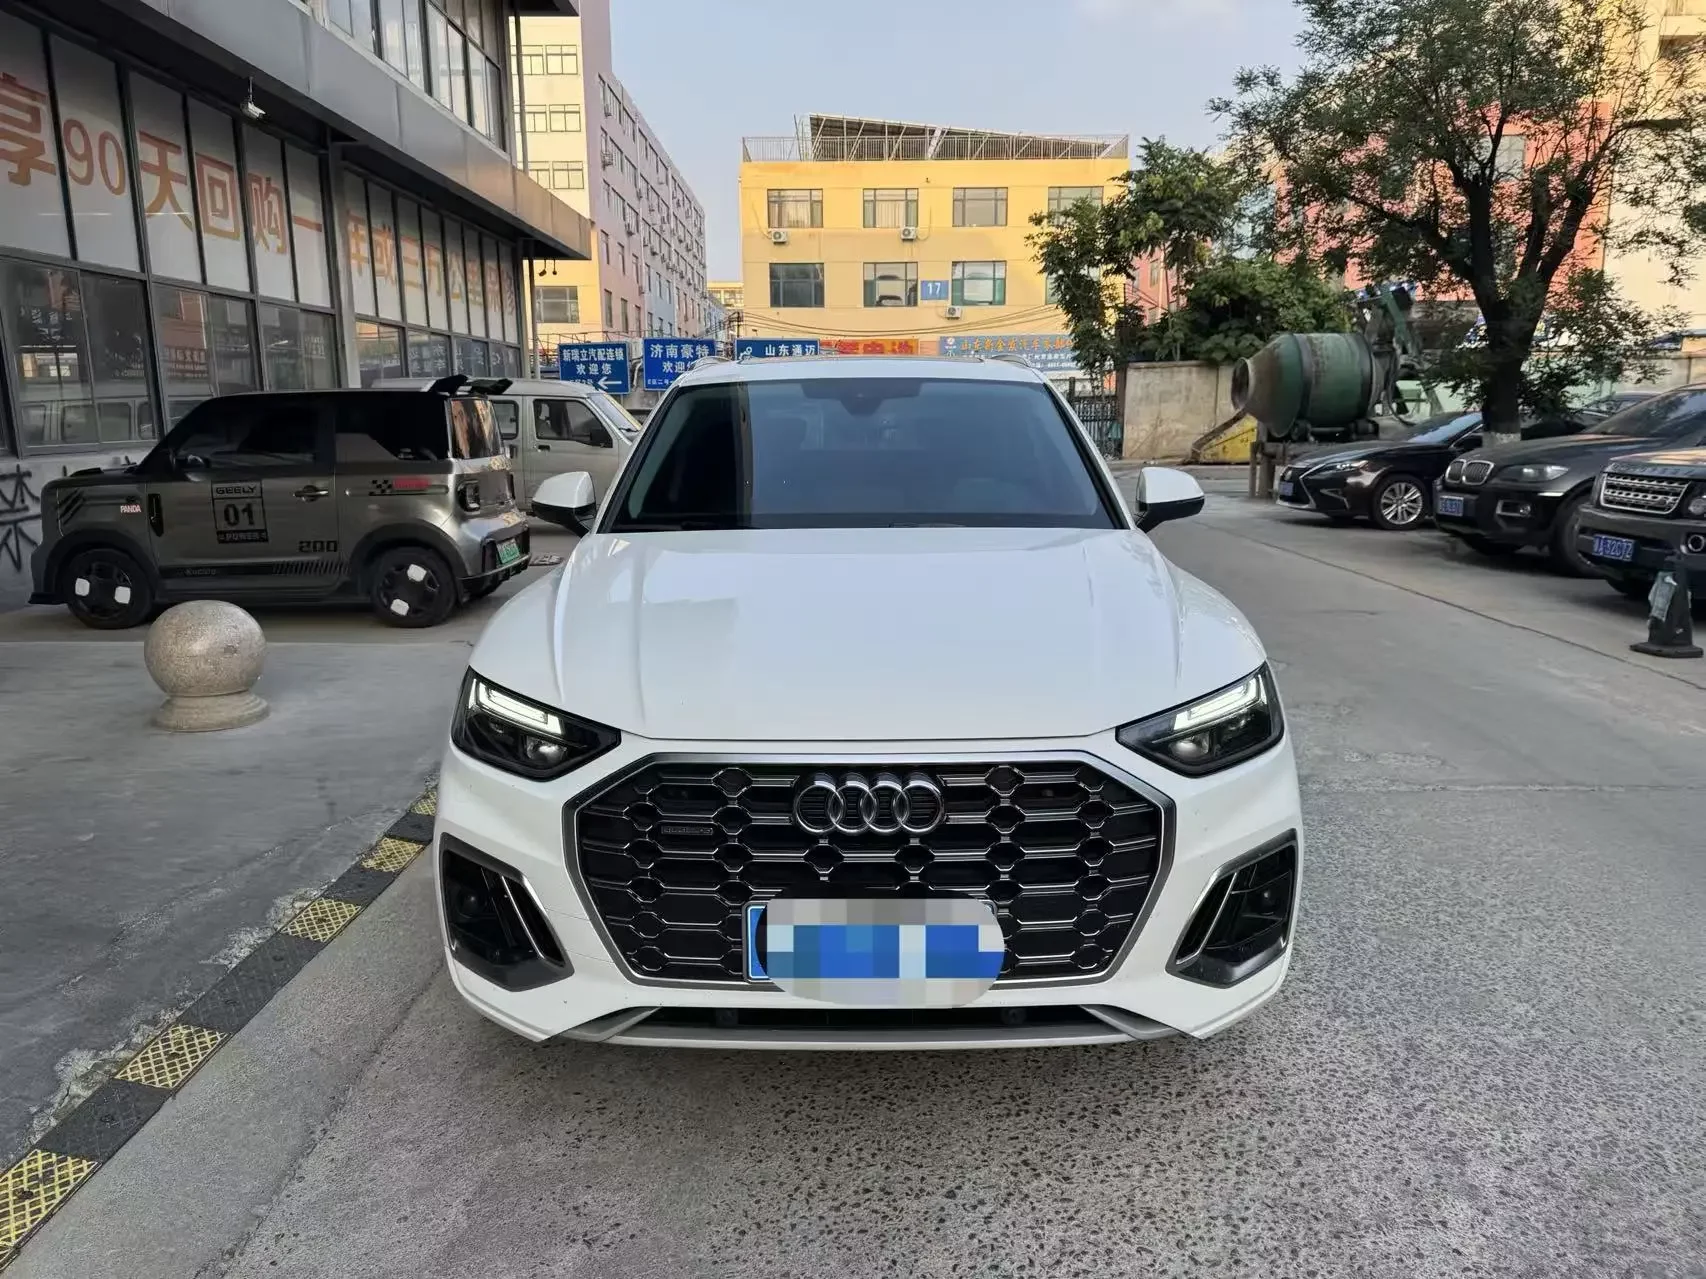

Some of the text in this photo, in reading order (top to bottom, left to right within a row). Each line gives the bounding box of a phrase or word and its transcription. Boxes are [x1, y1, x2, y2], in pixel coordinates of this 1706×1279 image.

[927, 282, 941, 295] 17
[562, 347, 624, 362] 新瑞立汽配连锁
[650, 344, 710, 359] 济南豪特
[576, 363, 612, 375] 欢迎您
[215, 486, 257, 495] GEELY
[120, 504, 141, 513] PANDA
[223, 503, 255, 527] 01
